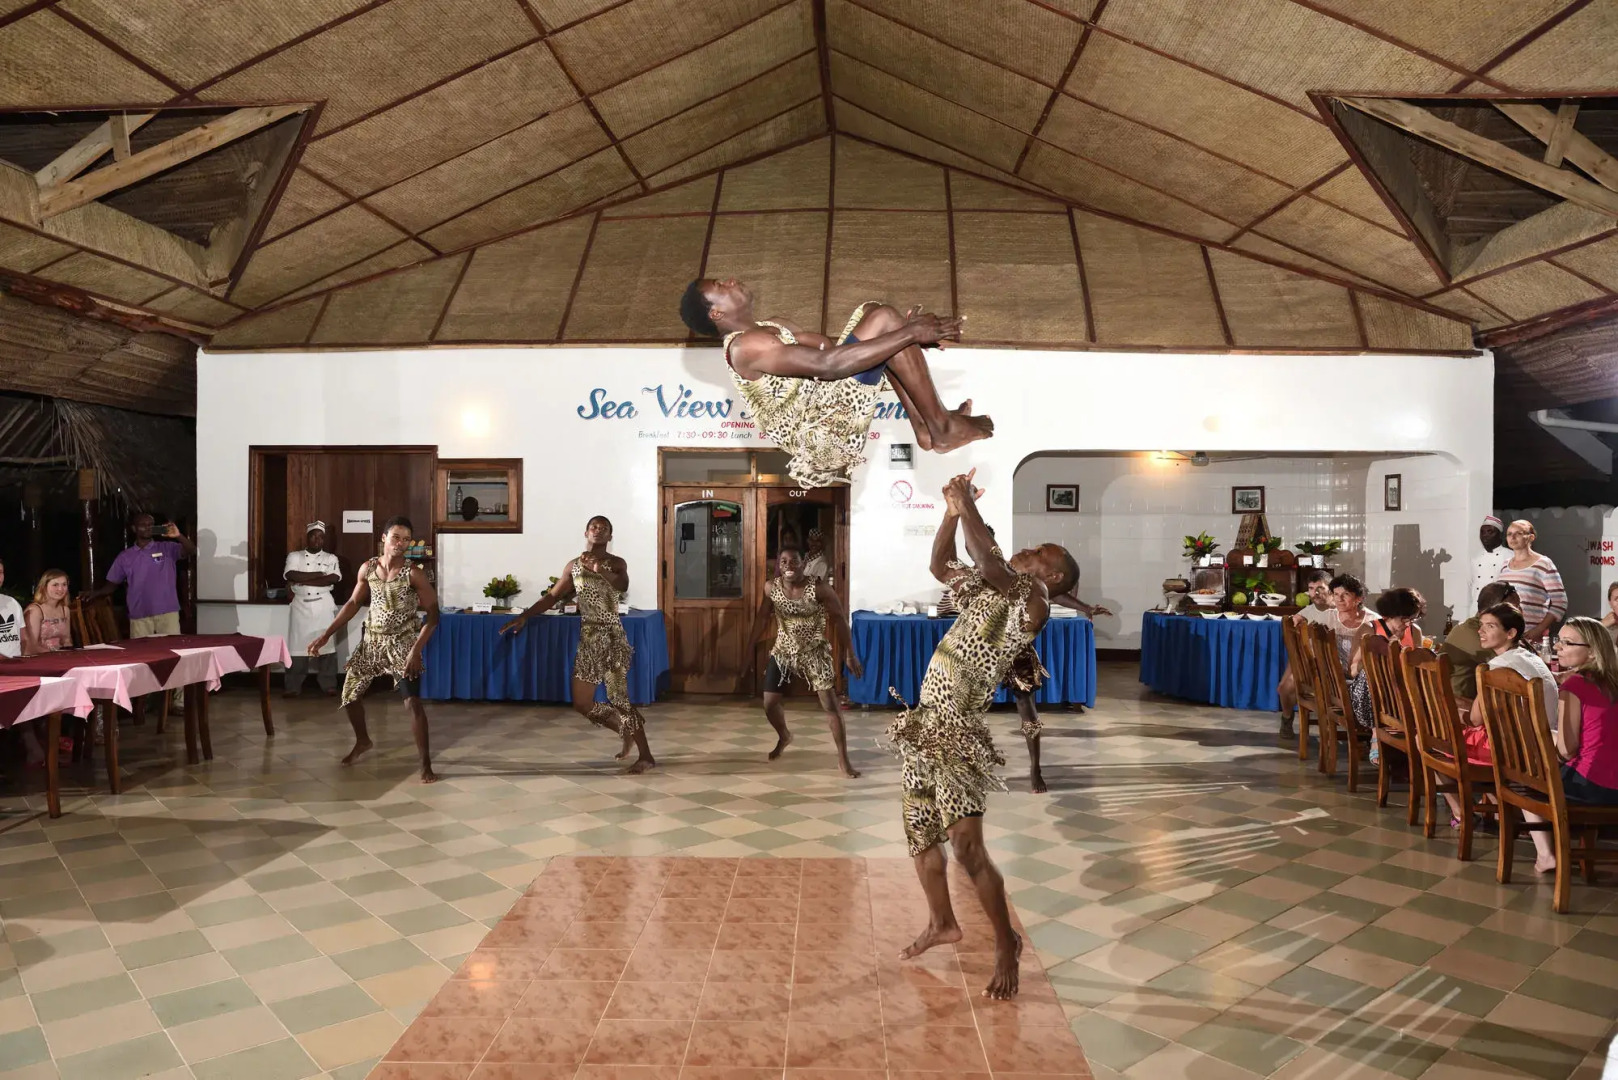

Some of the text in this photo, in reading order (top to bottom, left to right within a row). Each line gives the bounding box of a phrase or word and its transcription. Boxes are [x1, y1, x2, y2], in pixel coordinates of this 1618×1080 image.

[577, 388, 638, 420] Sea
[642, 384, 733, 419] View
[720, 421, 756, 429] OPENING
[730, 431, 752, 439] Lunch
[701, 489, 714, 498] IN
[1589, 540, 1614, 551] WASH
[1590, 555, 1616, 566] ROOMS
[0, 633, 20, 643] didas
